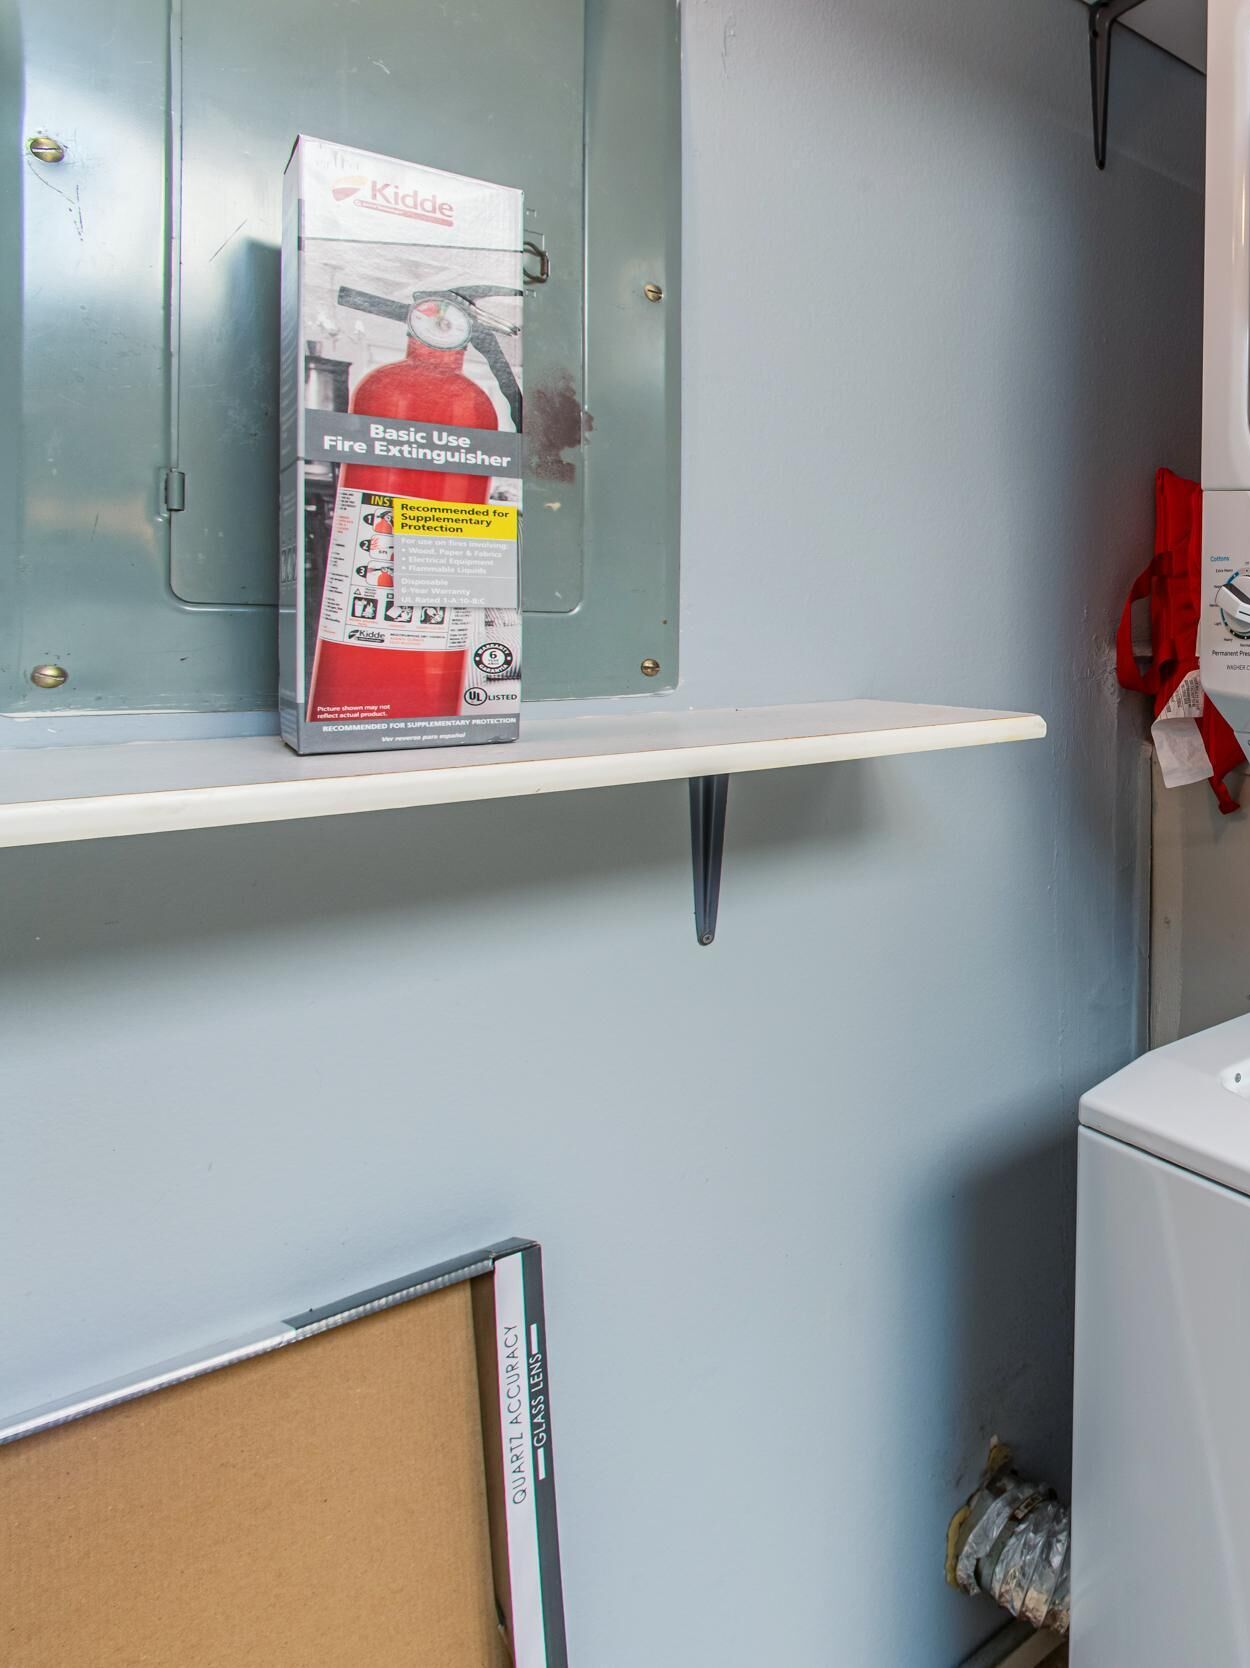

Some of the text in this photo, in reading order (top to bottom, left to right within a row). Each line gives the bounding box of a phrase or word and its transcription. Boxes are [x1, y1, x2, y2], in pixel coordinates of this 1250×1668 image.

[371, 180, 454, 218] Kidde
[370, 423, 471, 448] Basic Use
[323, 435, 511, 467] Fire Extinguisher
[370, 495, 391, 507] INS
[400, 503, 509, 518] Recommended for
[367, 515, 372, 524] 1
[401, 512, 492, 527] Supplementary
[400, 522, 463, 533] Protection
[362, 540, 369, 549] 2
[439, 548, 463, 557] Paper
[474, 550, 502, 558] Fabrics
[408, 556, 494, 566] Electrical Equipment
[359, 567, 365, 575] 3
[408, 565, 487, 574] Flammable Liquids
[401, 578, 448, 586] Disposable
[431, 587, 471, 596] Warranty
[359, 629, 386, 640] Kidde
[489, 650, 497, 659] 6
[468, 690, 482, 702] UL
[360, 711, 388, 719] product.
[322, 722, 388, 732] RECOMMENDED
[407, 719, 470, 729] SUPPLEMENTARY
[472, 717, 516, 726] PROTECTION
[530, 1352, 547, 1448] GLASS LENS
[503, 1325, 528, 1505] QUARTZ ACCURACY
